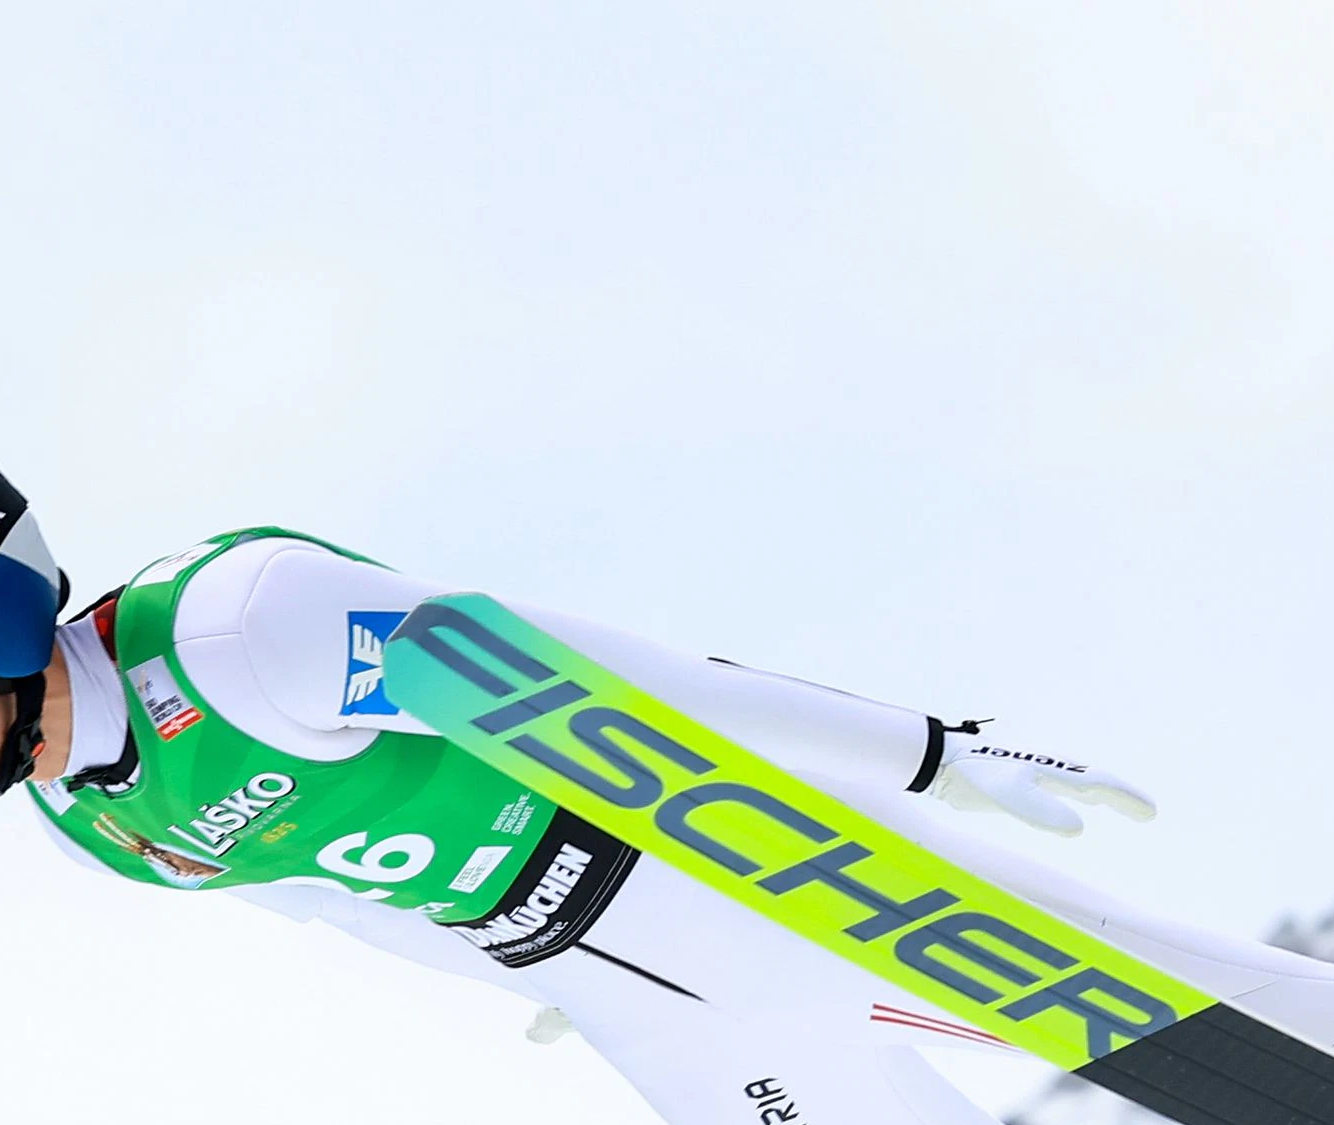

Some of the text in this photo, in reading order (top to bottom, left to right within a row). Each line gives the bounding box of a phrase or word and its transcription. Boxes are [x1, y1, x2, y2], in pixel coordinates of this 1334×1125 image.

[970, 745, 1090, 773] ziener
[166, 772, 297, 858] LAŠKO
[389, 604, 1179, 1061] FISCHER
